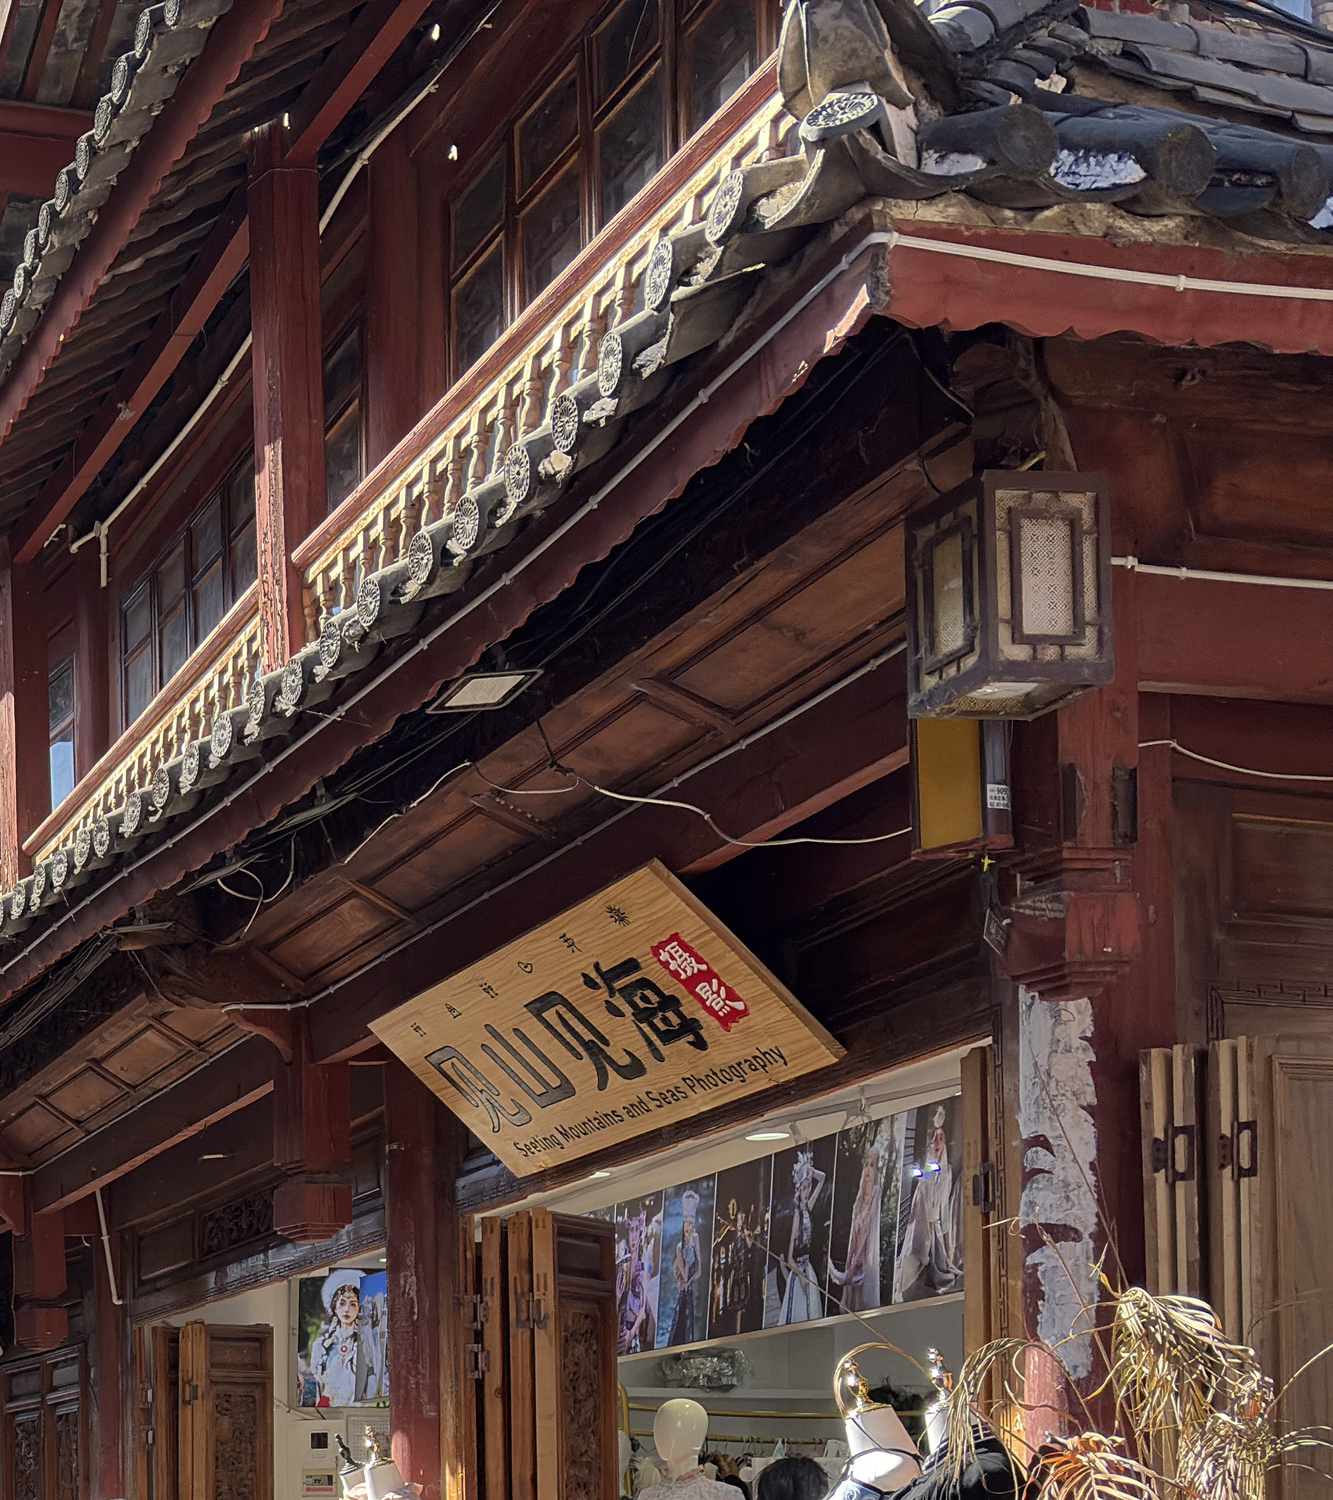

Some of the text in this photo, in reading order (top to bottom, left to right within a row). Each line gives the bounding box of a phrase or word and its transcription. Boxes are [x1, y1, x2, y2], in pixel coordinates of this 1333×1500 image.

[659, 941, 745, 1017] 摄影
[424, 957, 708, 1133] 见山见海
[556, 1109, 625, 1142] Mountains
[623, 1096, 652, 1119] and
[645, 1084, 688, 1109] Seas
[681, 1045, 789, 1095] Photography
